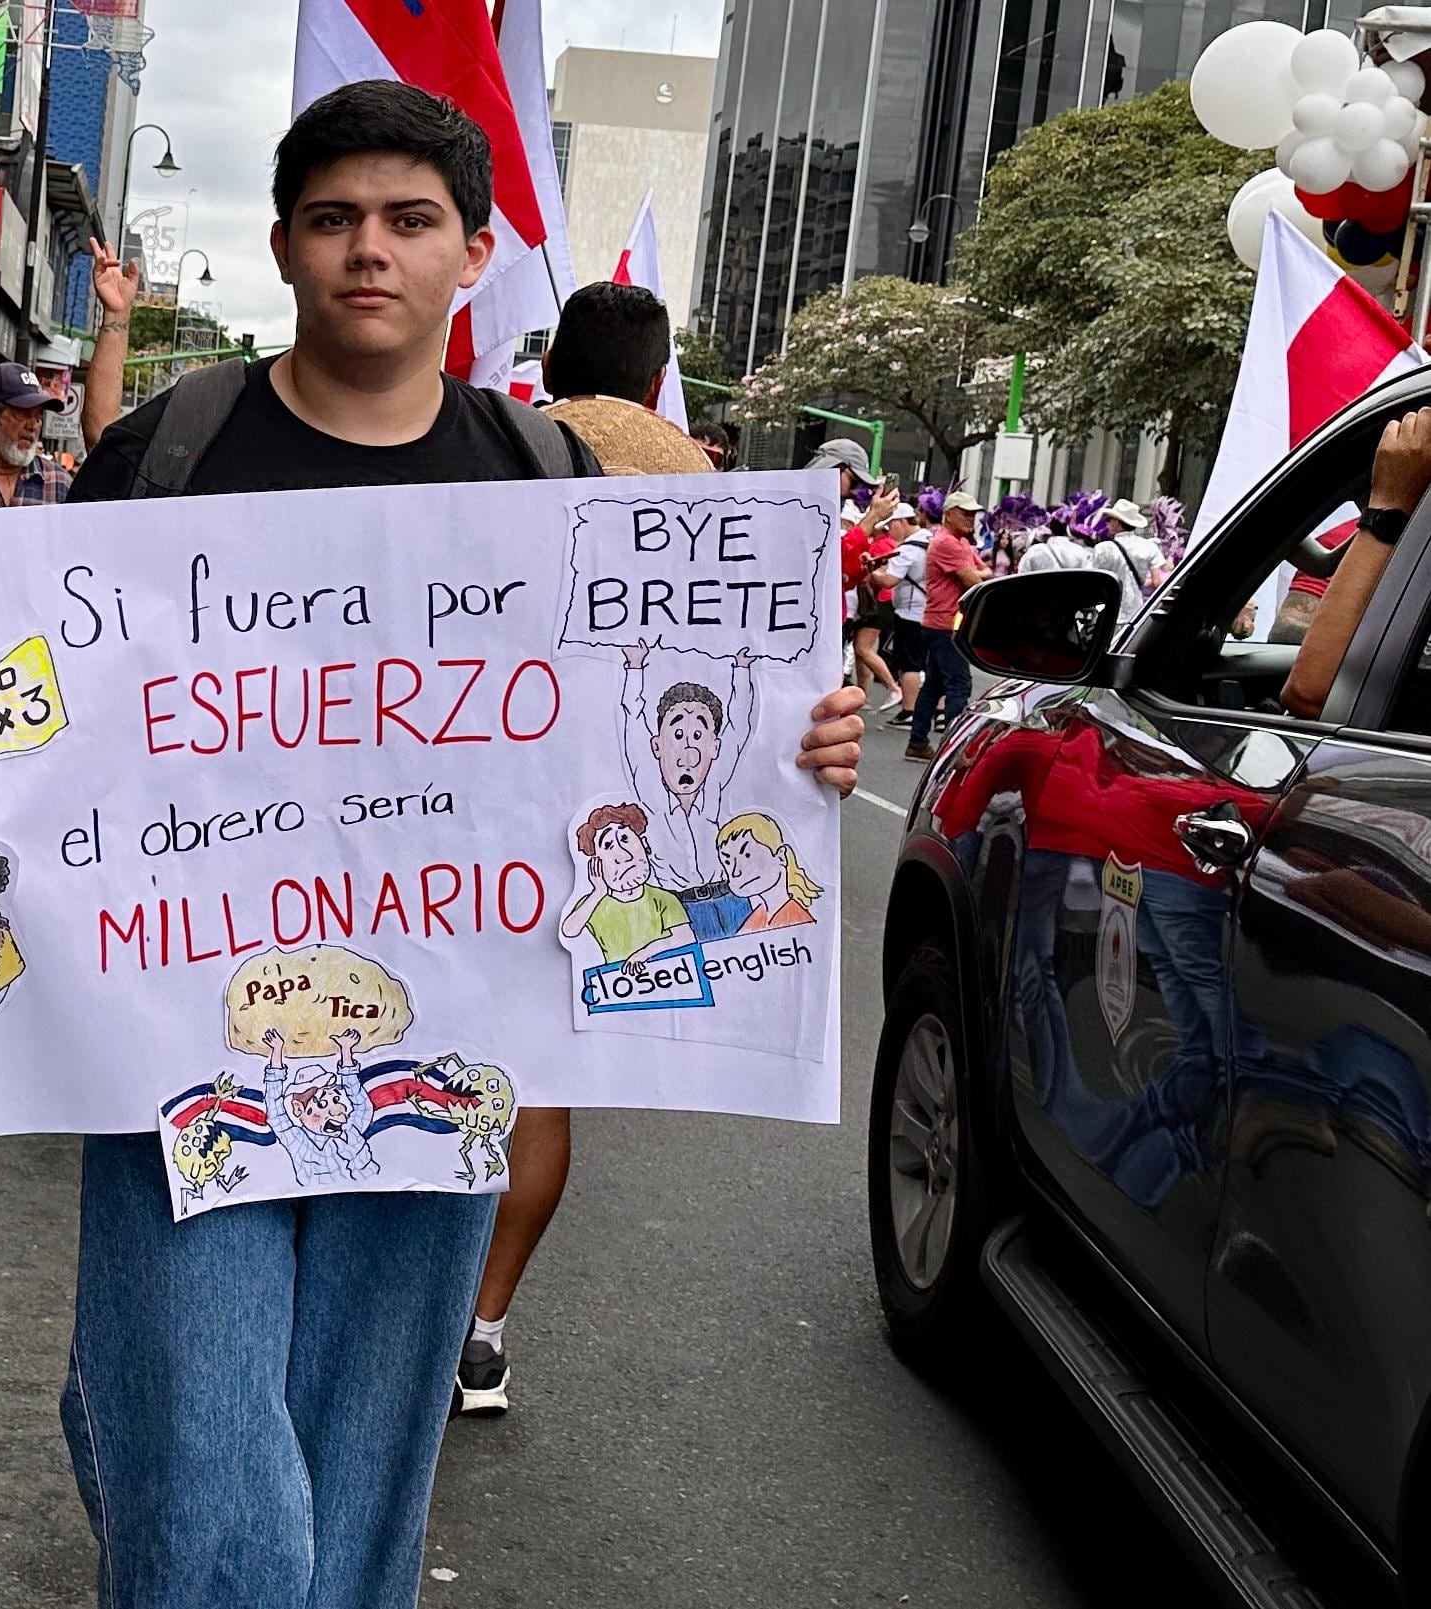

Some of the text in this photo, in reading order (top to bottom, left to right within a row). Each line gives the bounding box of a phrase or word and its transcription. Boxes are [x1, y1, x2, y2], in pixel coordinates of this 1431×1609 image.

[634, 509, 757, 562] BYE
[62, 554, 526, 648] Si fuera por
[588, 578, 806, 632] BRETE
[143, 658, 559, 754] ESFUERZO
[62, 783, 453, 866] el obrero sería
[1109, 873, 1133, 898] APSE
[246, 974, 379, 1019] Papa Tica
[581, 937, 812, 1006] closed english
[465, 1112, 503, 1137] USA
[190, 1148, 228, 1180] USA
